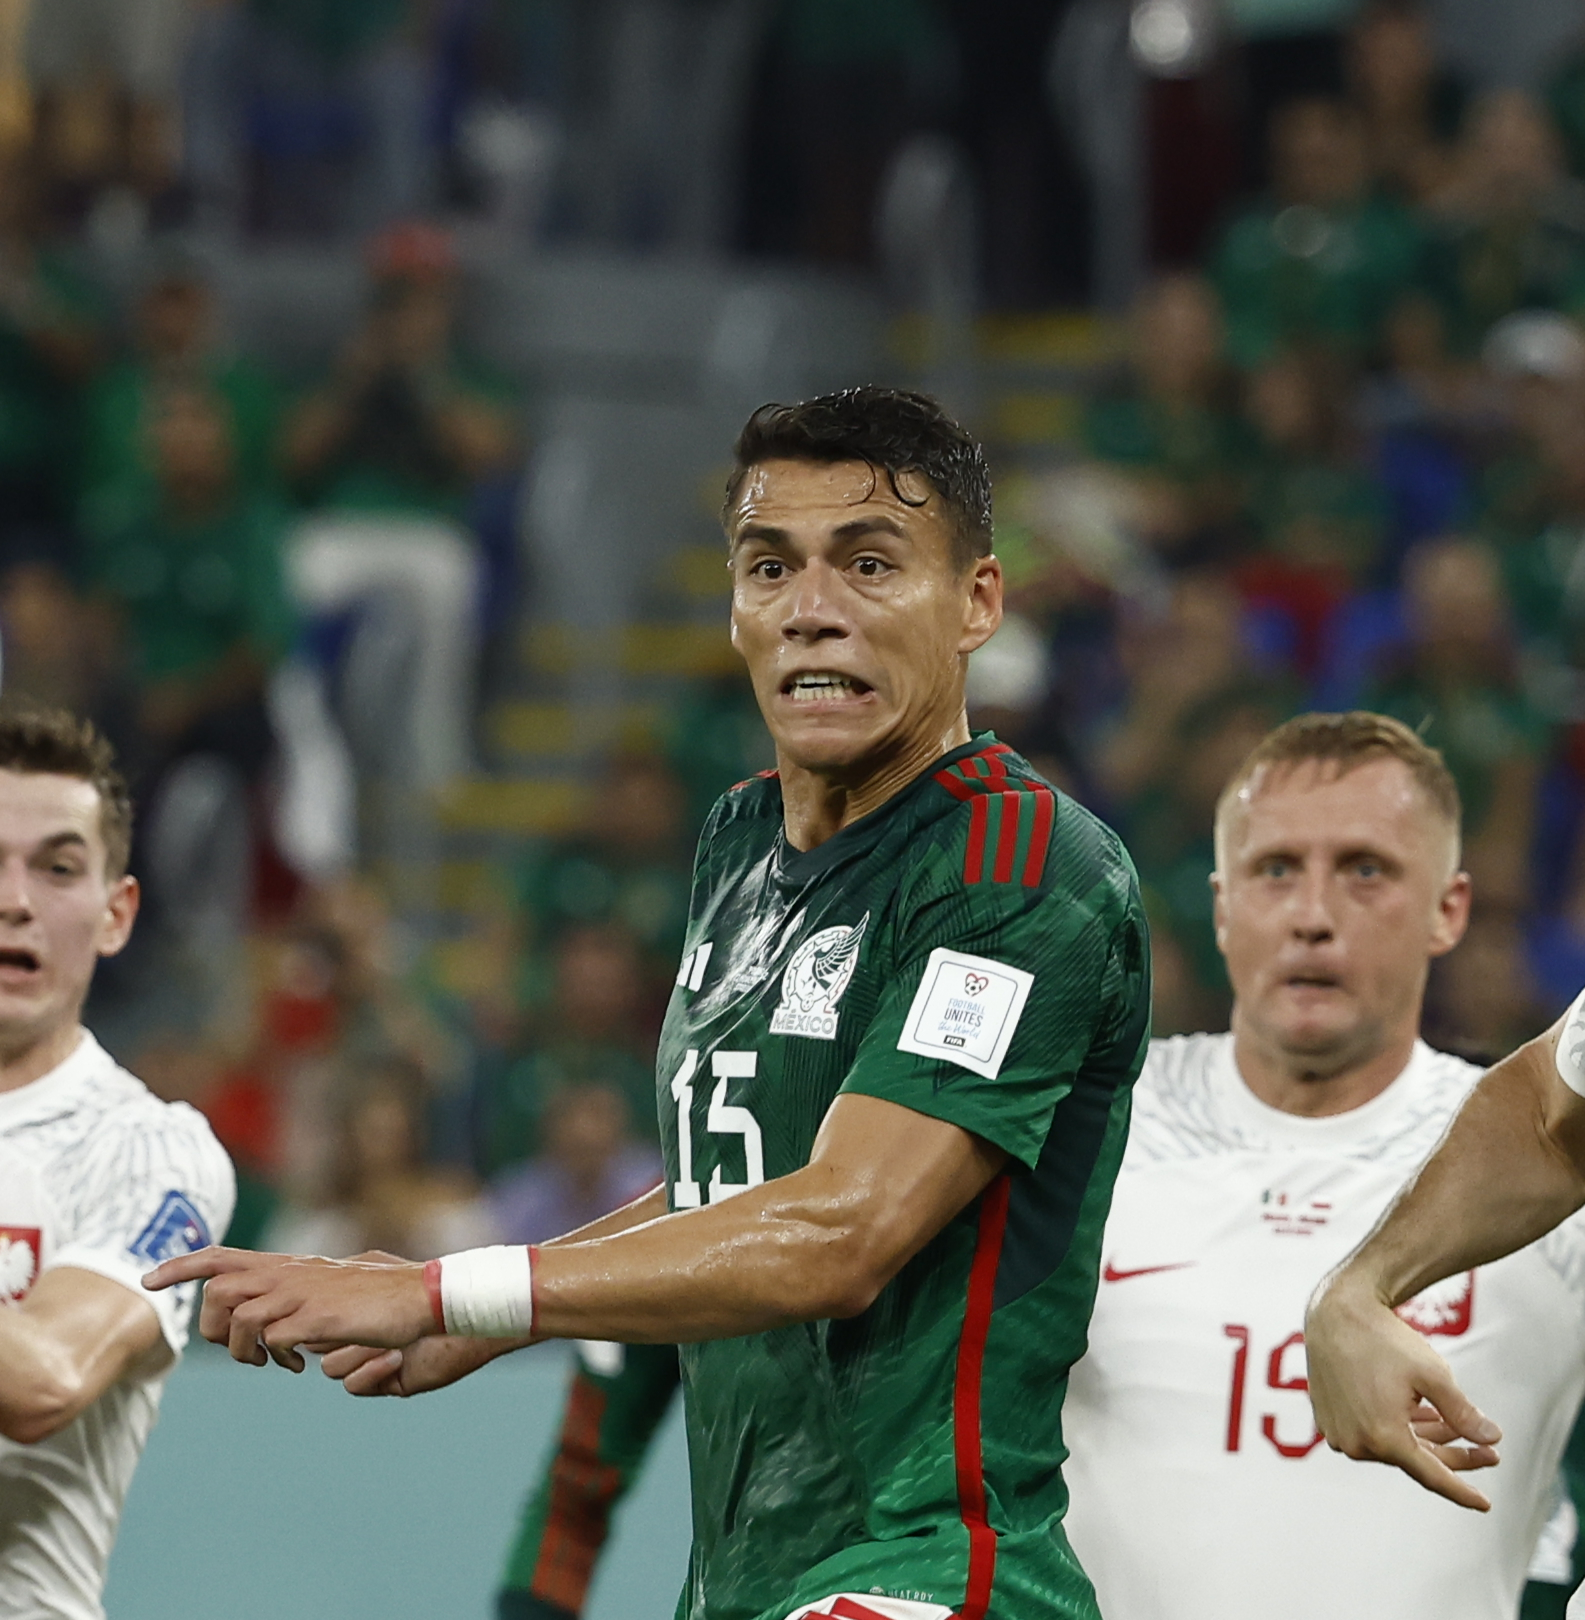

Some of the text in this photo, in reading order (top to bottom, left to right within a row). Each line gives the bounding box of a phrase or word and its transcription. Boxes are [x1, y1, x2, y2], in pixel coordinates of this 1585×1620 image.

[947, 997, 986, 1014] FOOTBALL
[943, 1007, 984, 1028] UNITES
[671, 1049, 765, 1208] 15
